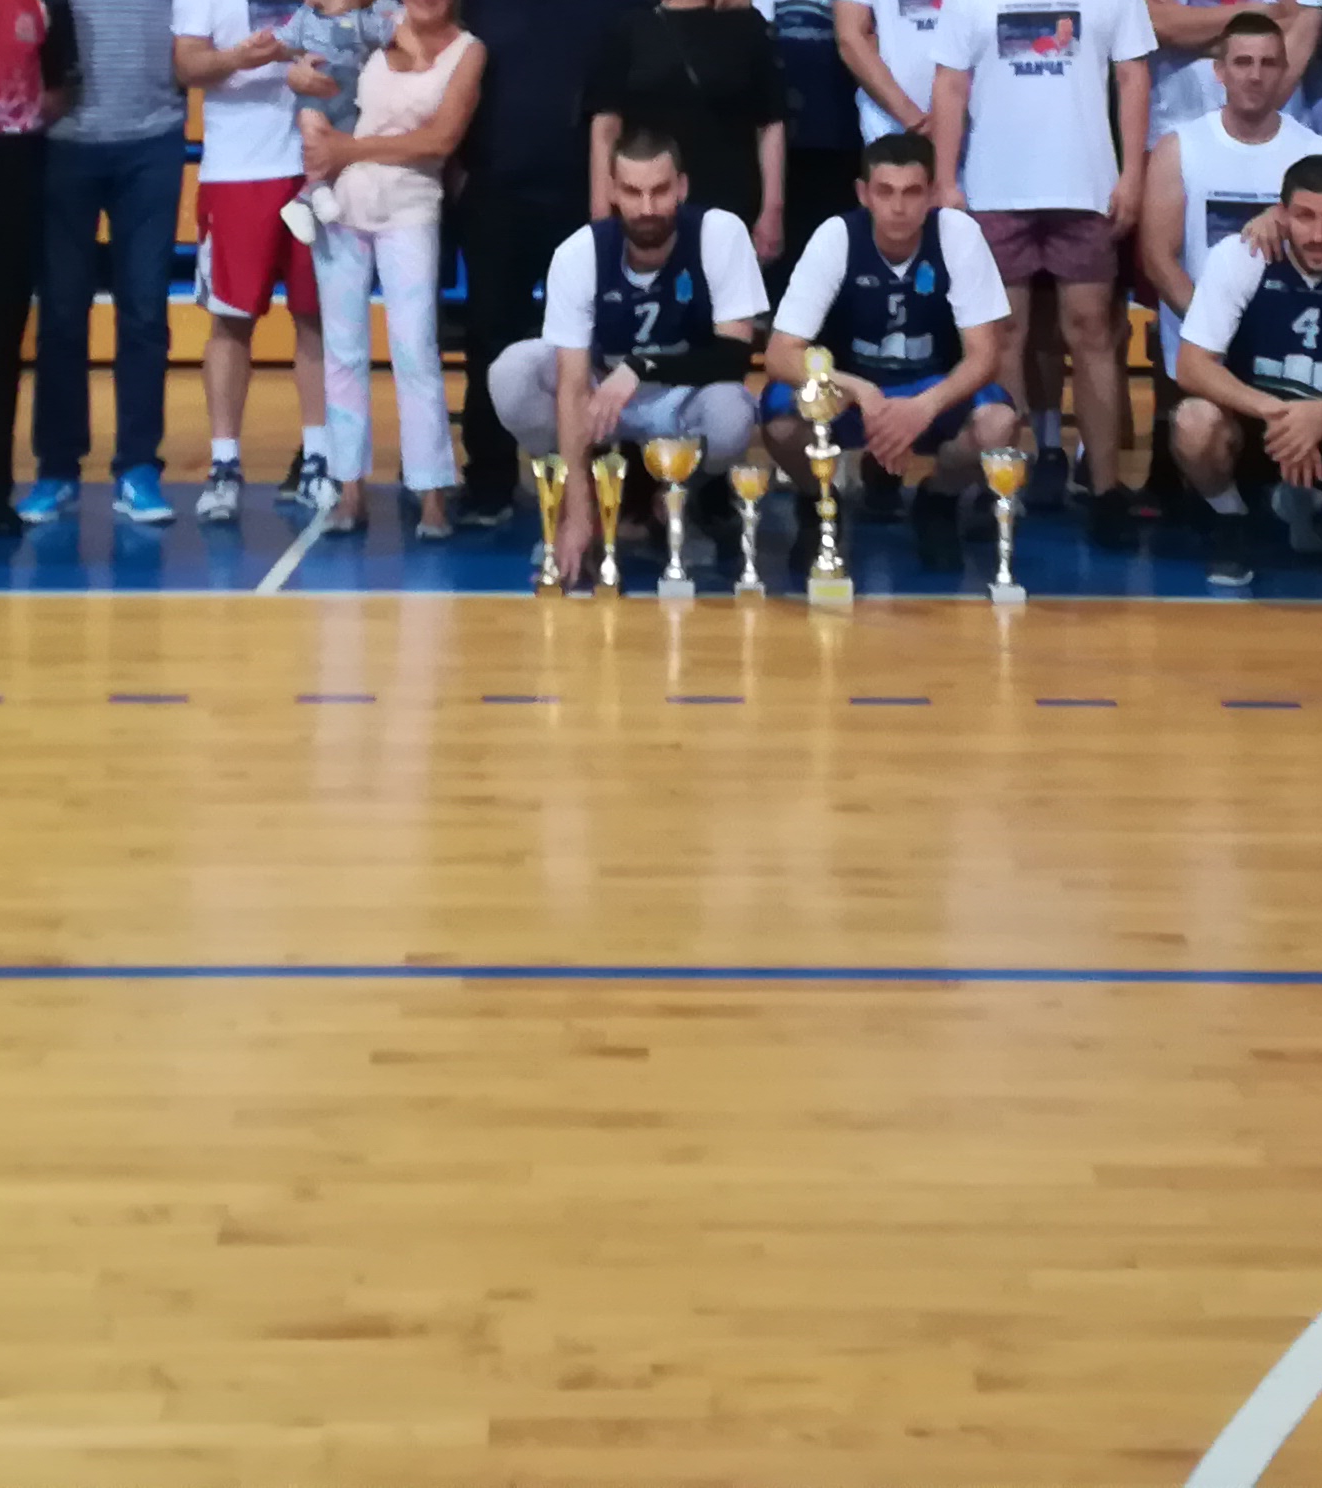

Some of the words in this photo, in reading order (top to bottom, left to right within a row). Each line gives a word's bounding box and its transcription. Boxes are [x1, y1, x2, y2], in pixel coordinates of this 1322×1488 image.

[634, 301, 660, 343] 7
[887, 294, 906, 328] 5
[1291, 307, 1321, 349] 4
